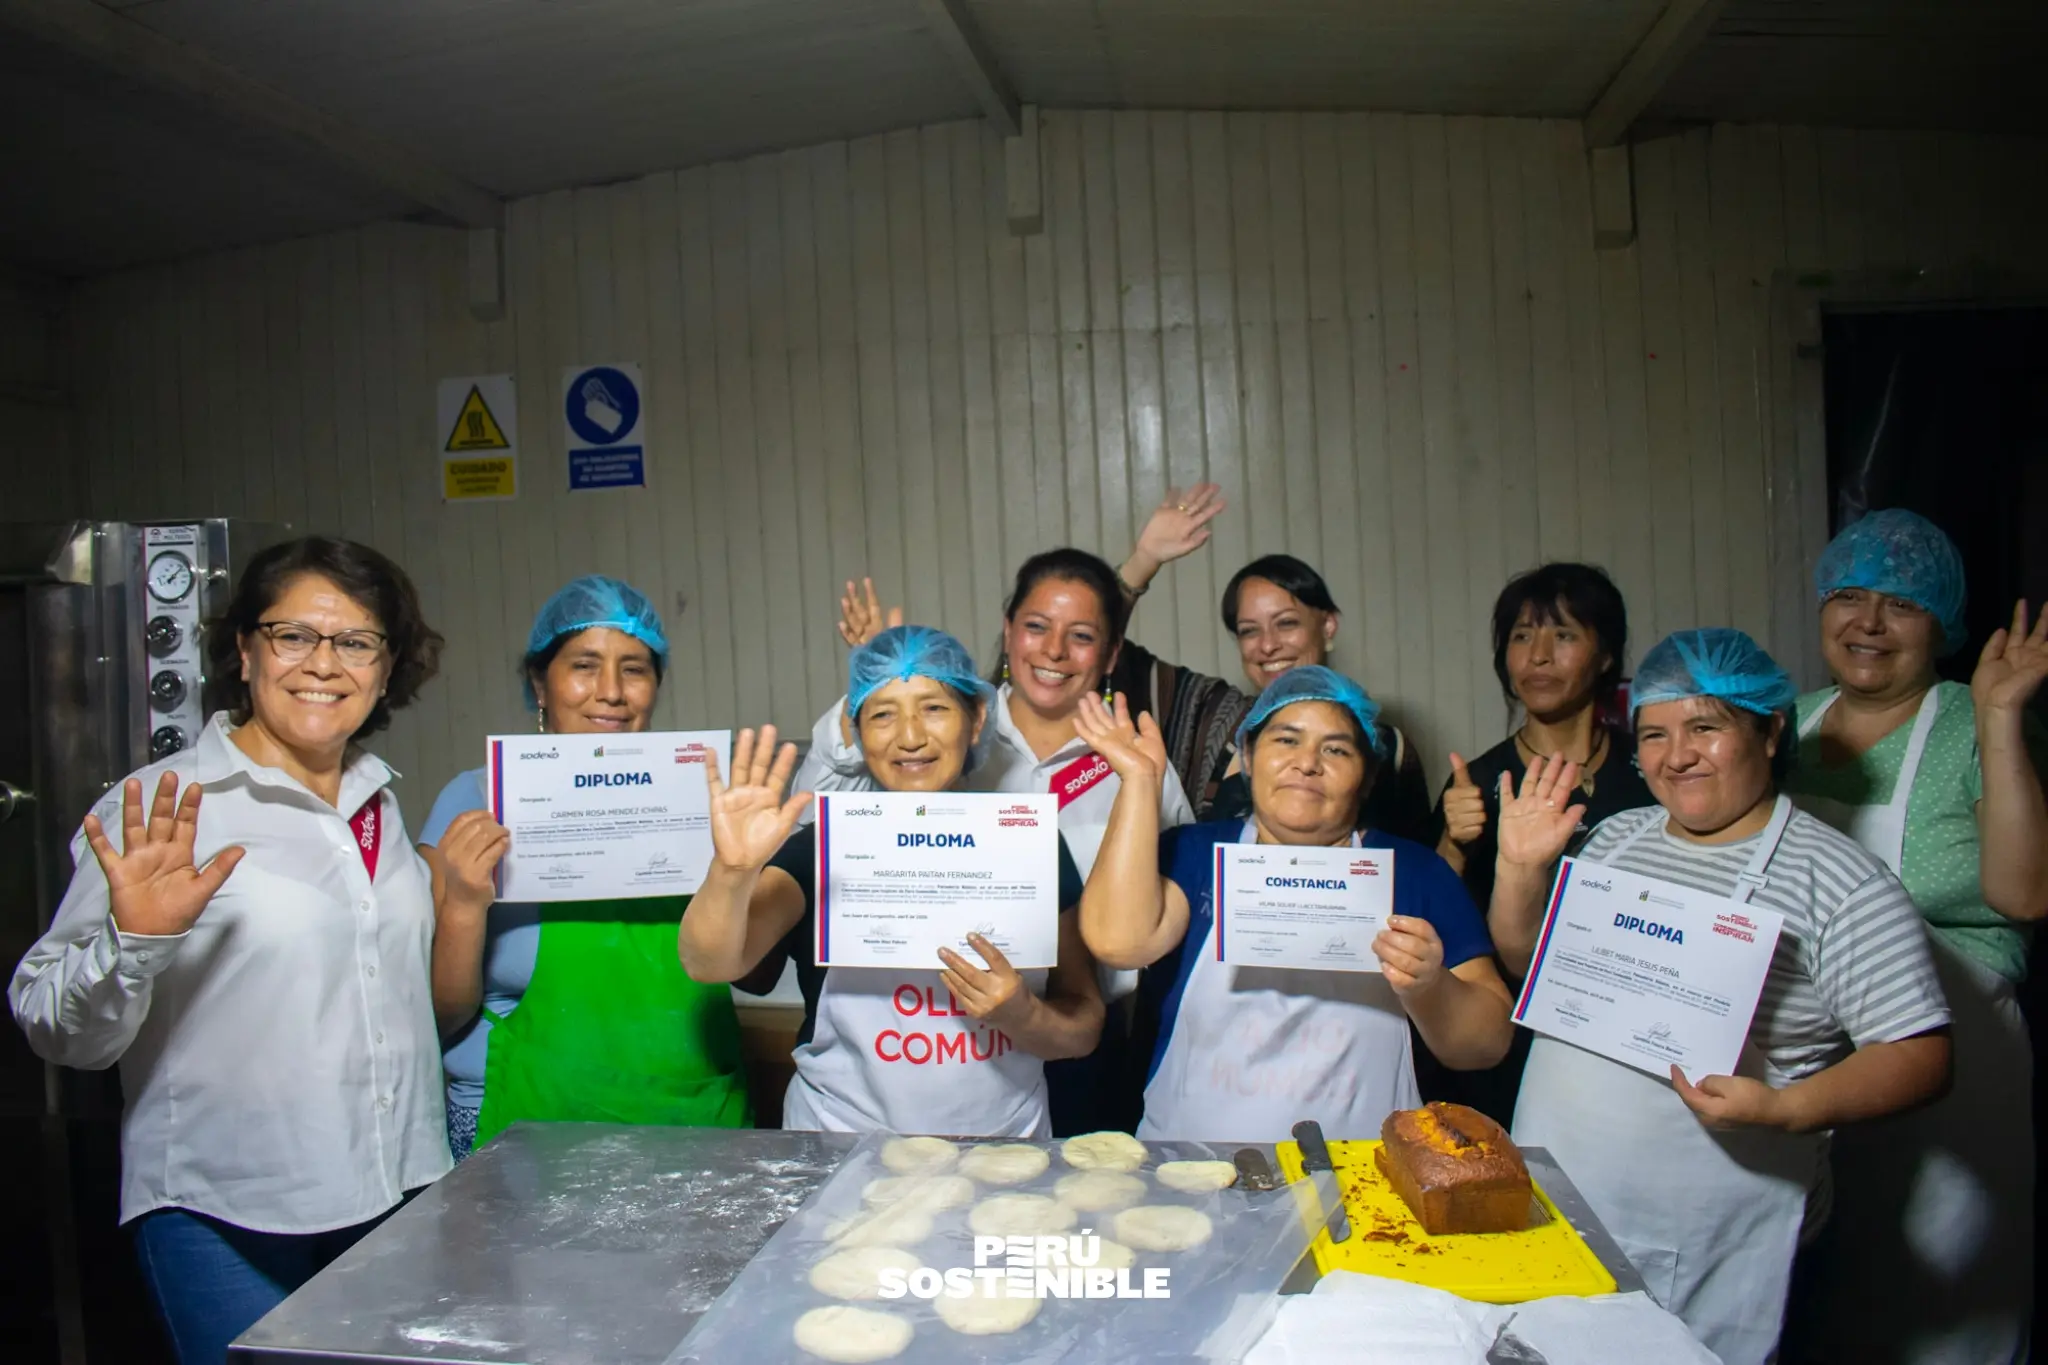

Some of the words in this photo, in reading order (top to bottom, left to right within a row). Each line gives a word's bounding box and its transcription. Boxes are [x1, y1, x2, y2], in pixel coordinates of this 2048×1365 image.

[520, 747, 560, 760] sodexo
[574, 771, 653, 788] DIPLOMA
[1064, 755, 1109, 794] sodexo
[551, 811, 583, 819] CARMEN
[585, 809, 606, 817] ROSA
[607, 807, 639, 815] MENDEZ
[844, 804, 883, 816] sodexo
[897, 833, 976, 848] DIPLOMA
[873, 870, 917, 878] MARGARITA
[947, 871, 993, 879] FERNANDEZ
[1265, 876, 1347, 890] CONSTANCIA
[1580, 879, 1612, 892] sodexo
[1613, 912, 1684, 945] DIPLOMA
[1615, 952, 1636, 965] MARIA
[1636, 958, 1658, 972] JESUS
[1659, 964, 1680, 979] PEÑA
[893, 983, 967, 1017] OLL
